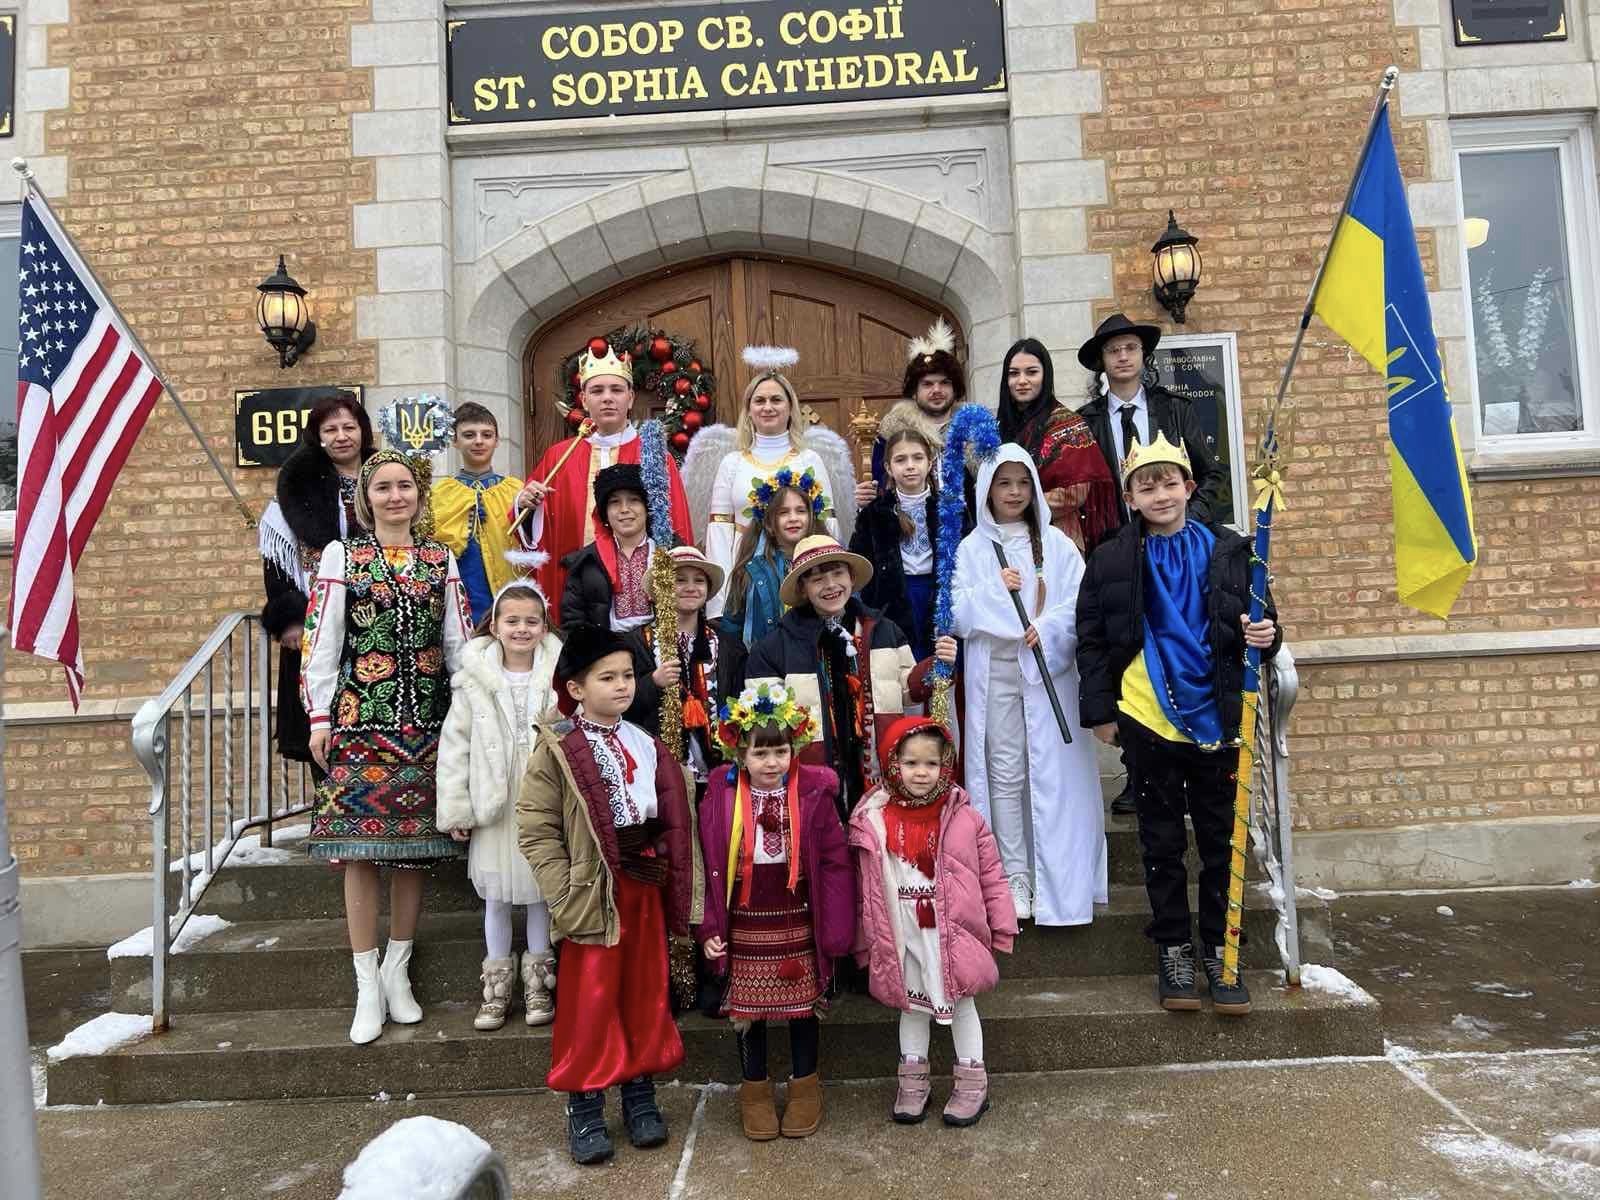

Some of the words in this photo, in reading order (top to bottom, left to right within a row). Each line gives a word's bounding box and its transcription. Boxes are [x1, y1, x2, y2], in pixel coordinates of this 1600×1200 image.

[541, 20, 684, 59] СОБОР
[697, 14, 765, 50] СВ.
[778, 0, 905, 46] СОФІЇ
[473, 76, 537, 112] ST.
[551, 66, 708, 106] SOPHIA
[720, 48, 979, 96] CATHEDRAL
[1163, 384, 1189, 392] OPHIA
